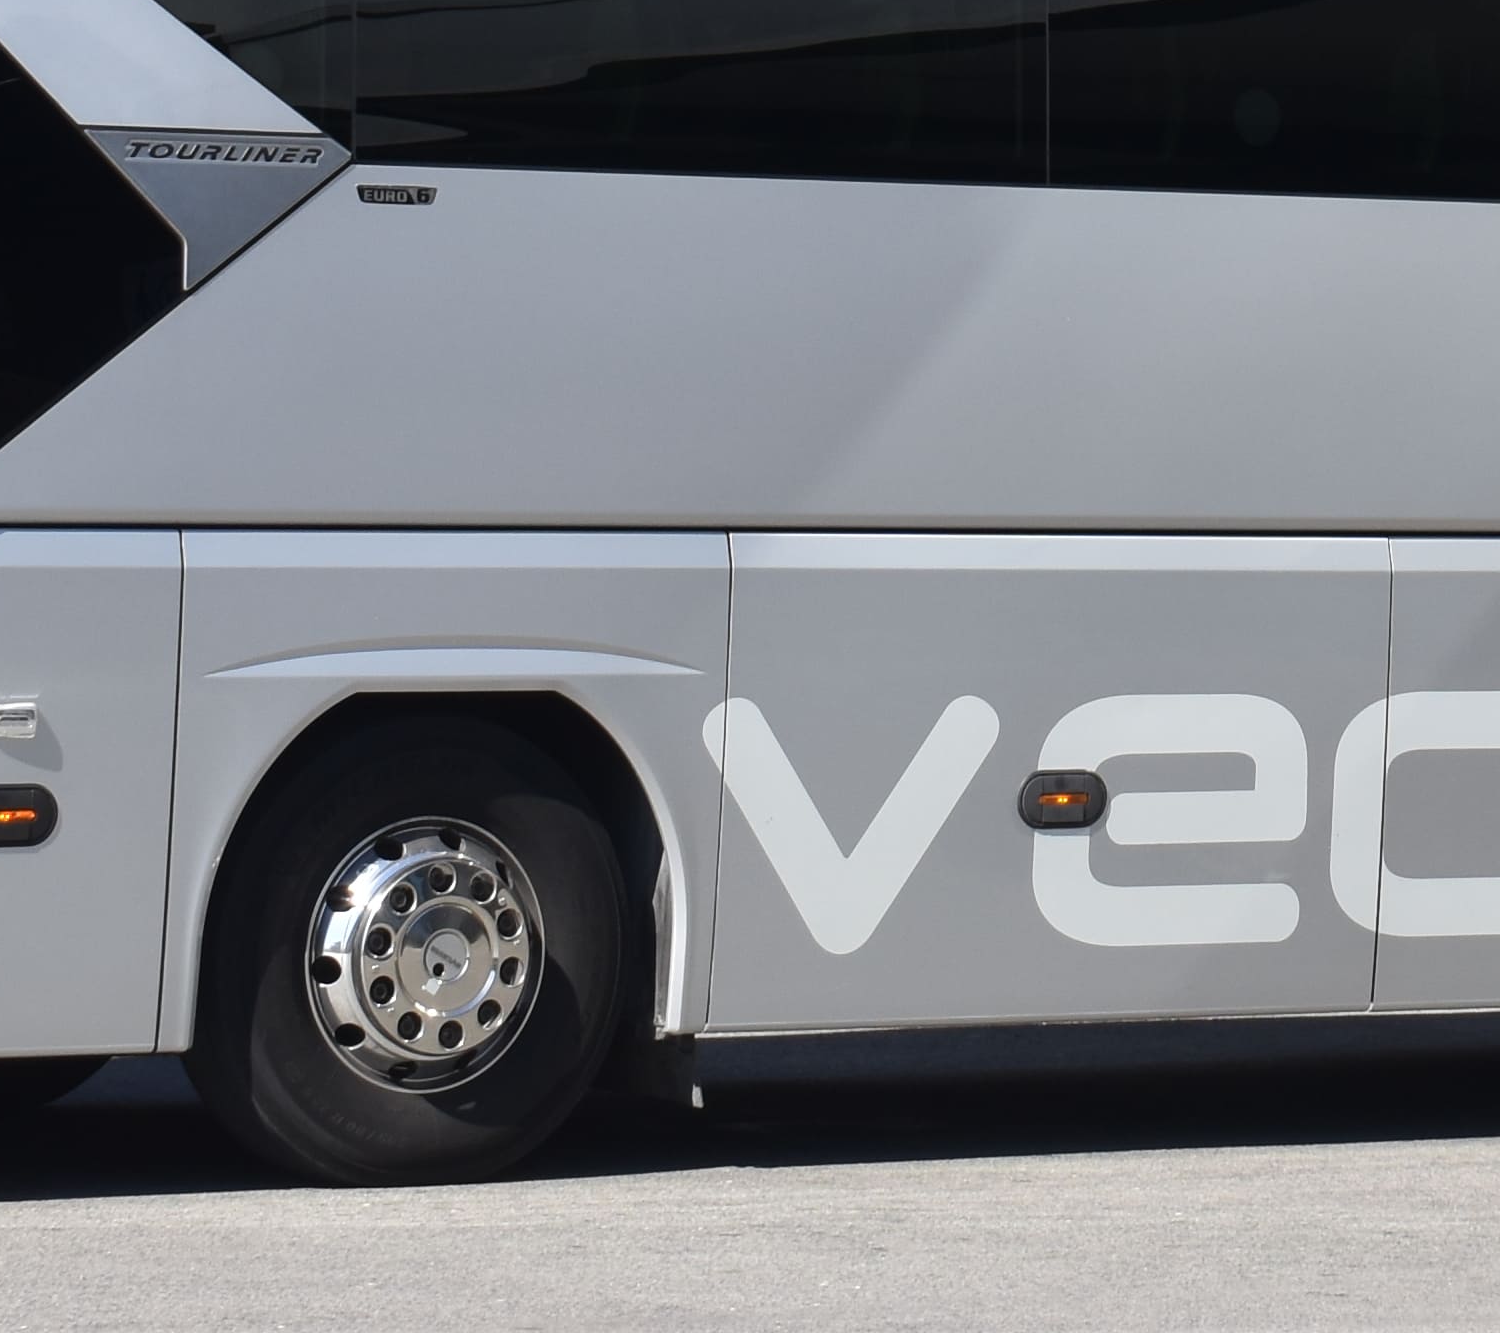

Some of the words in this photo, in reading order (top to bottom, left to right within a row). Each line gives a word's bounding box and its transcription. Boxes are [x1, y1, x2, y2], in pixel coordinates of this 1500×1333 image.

[127, 141, 325, 165] TOURLINER
[363, 188, 408, 203] EURO
[417, 188, 430, 203] 6
